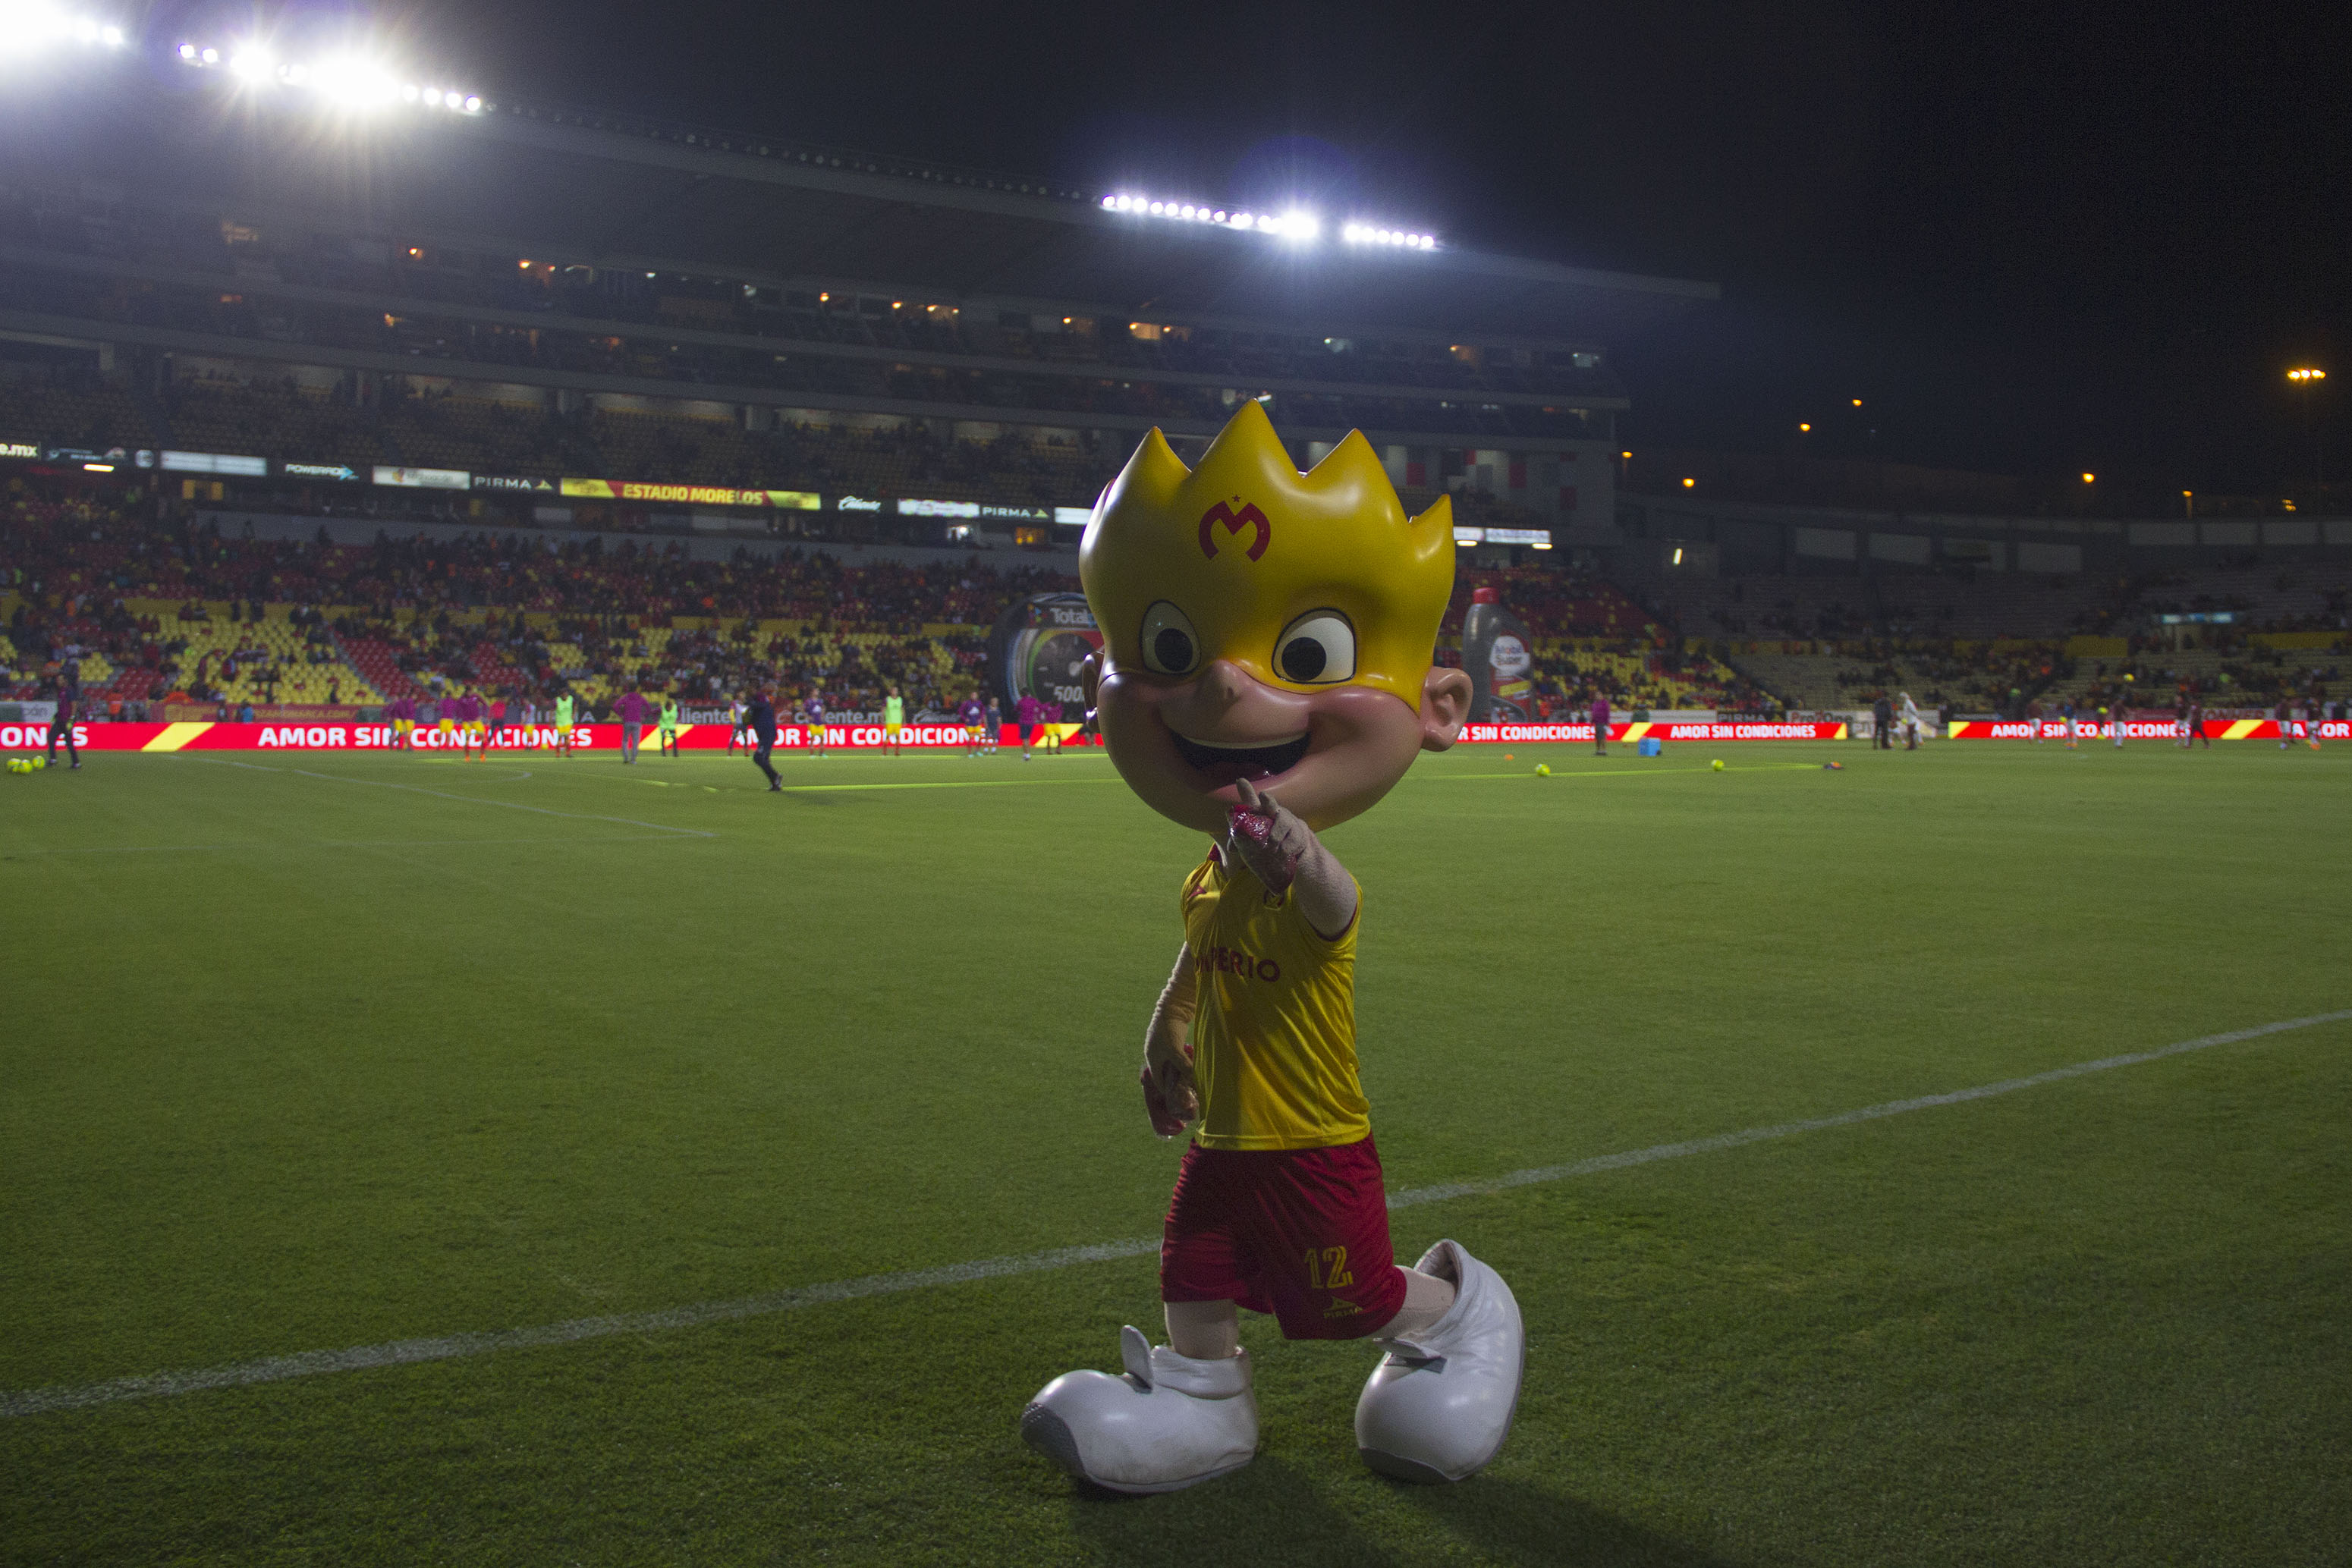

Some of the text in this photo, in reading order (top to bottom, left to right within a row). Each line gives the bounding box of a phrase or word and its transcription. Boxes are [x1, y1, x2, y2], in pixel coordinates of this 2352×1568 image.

[473, 476, 531, 489] PIRMA
[623, 484, 688, 502] ESTADIO
[690, 488, 763, 505] MORELOS
[983, 507, 1031, 517] PIRMA
[258, 727, 347, 746] AMOR
[1471, 726, 1498, 740] SIN
[1670, 724, 1816, 739] AMOR SIN CONDICIONES
[2292, 723, 2350, 737] AOR
[1304, 1246, 1354, 1288] 12
